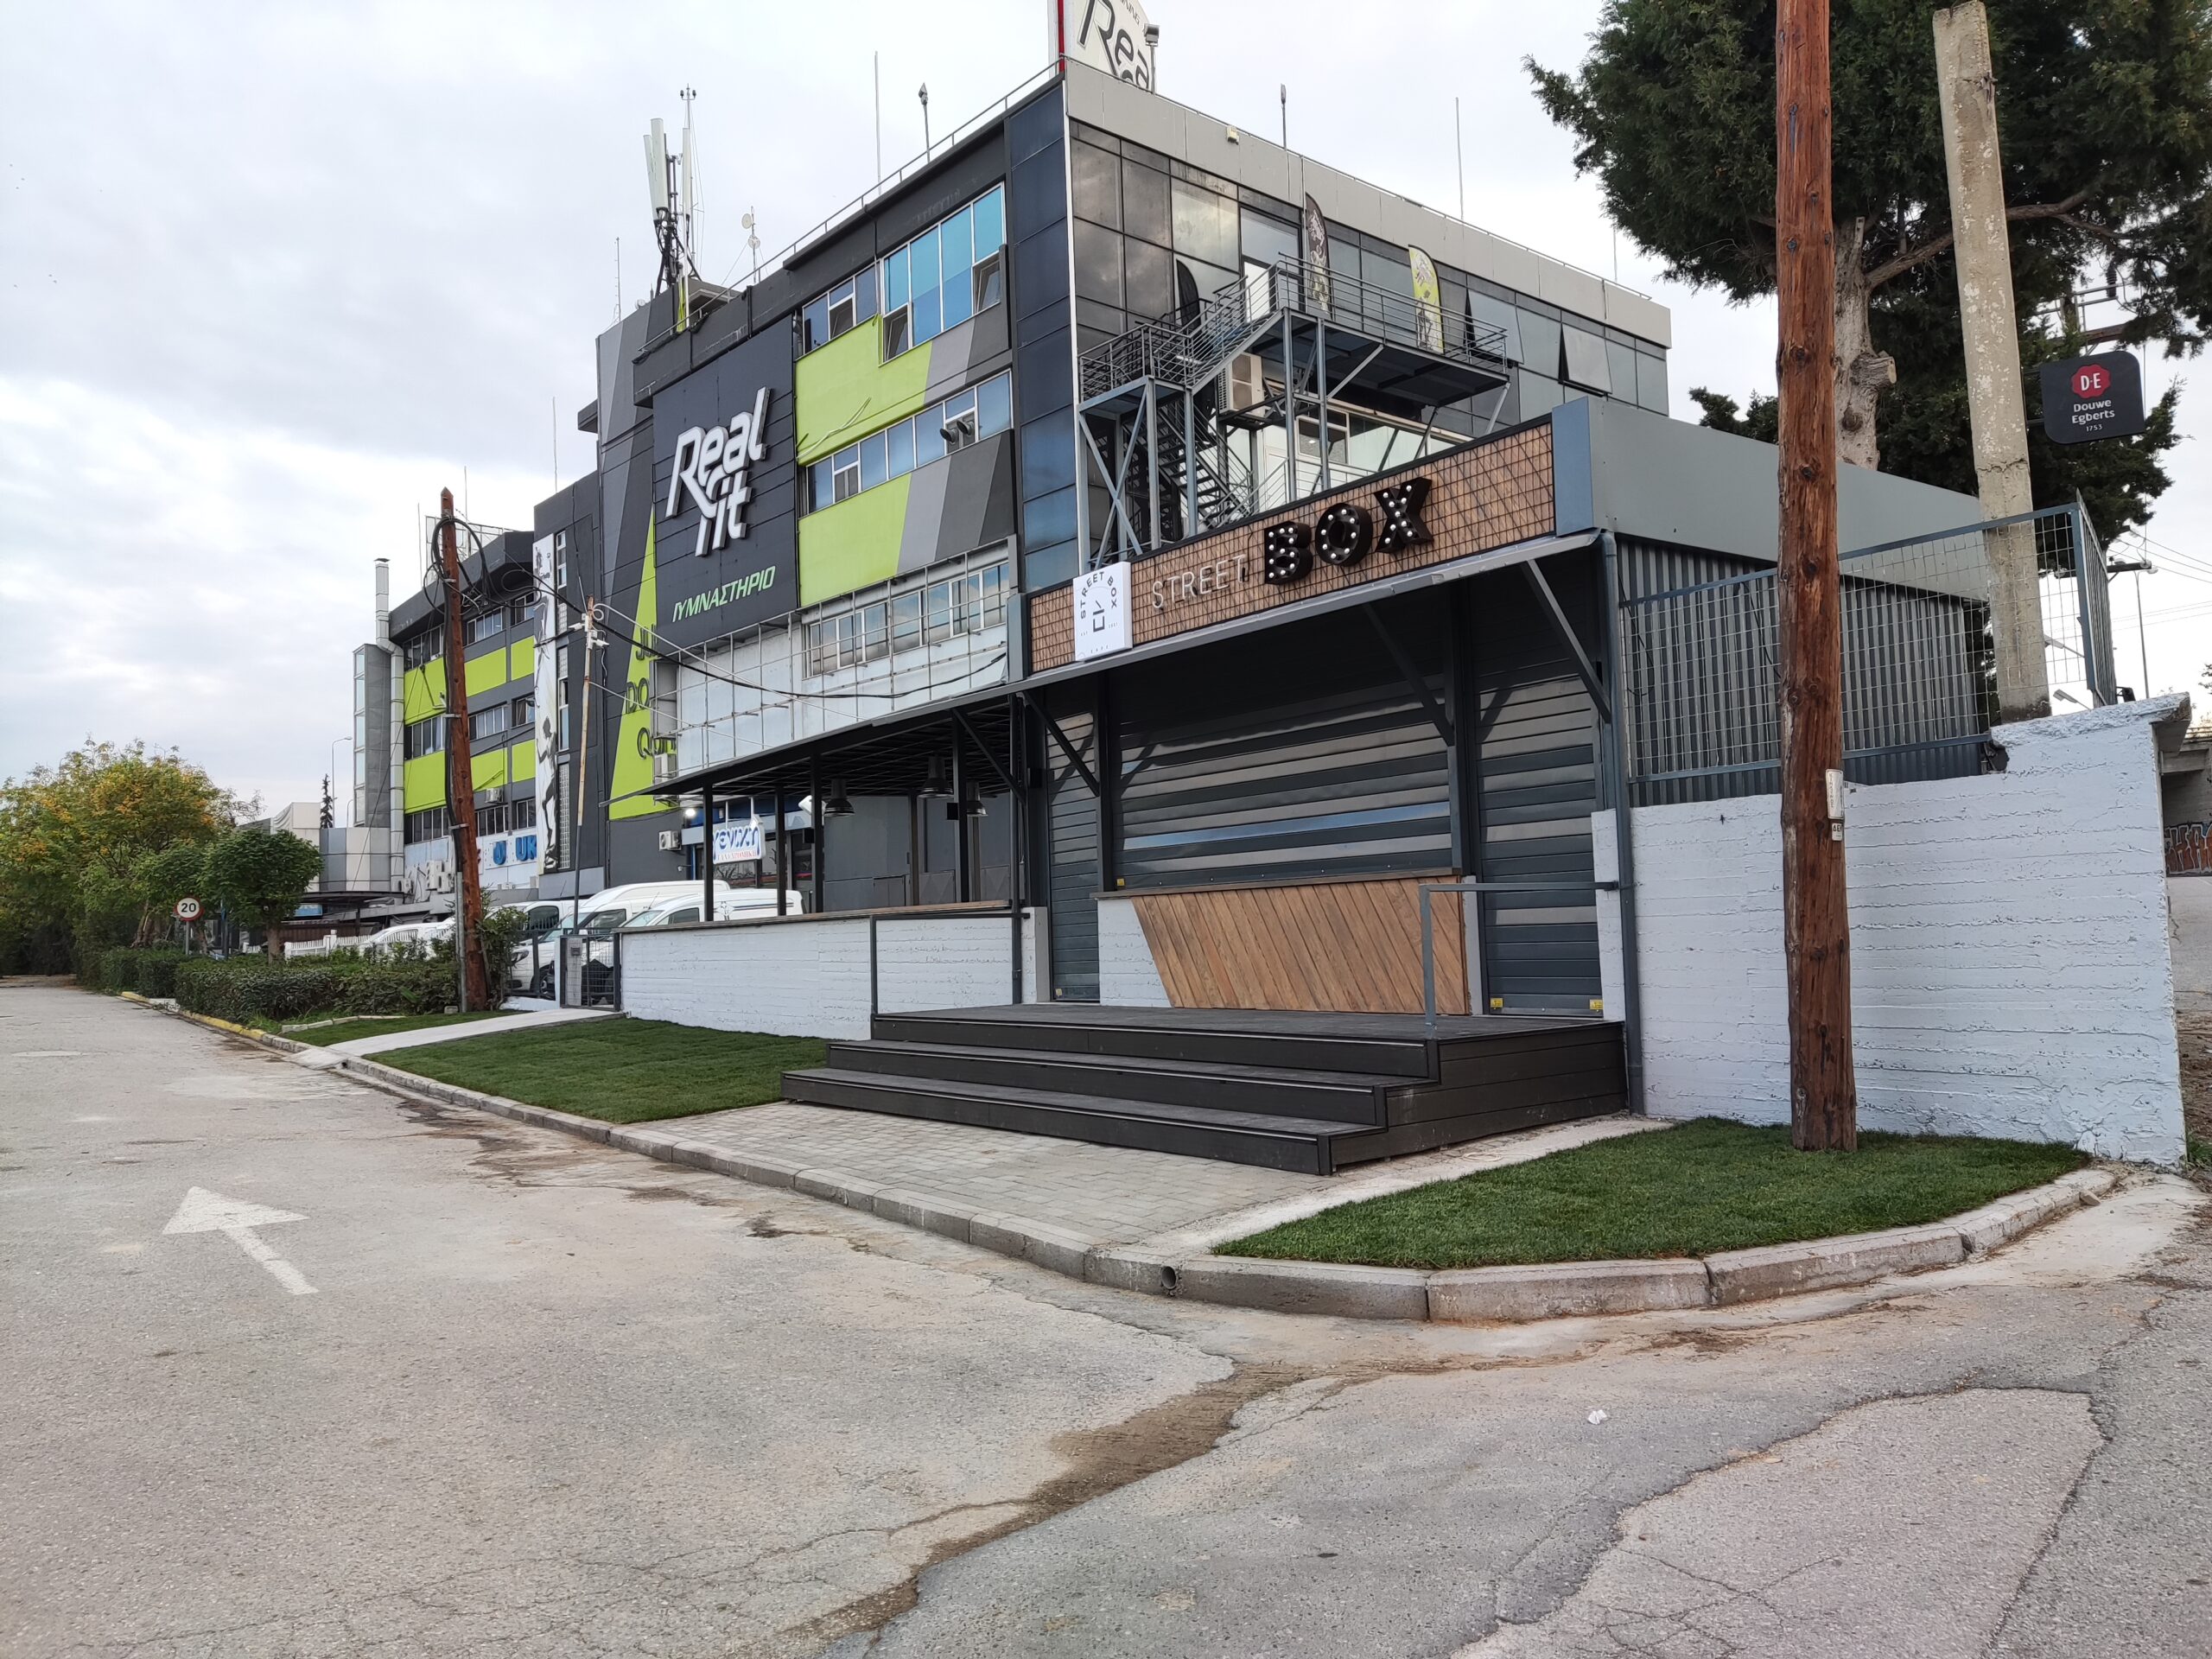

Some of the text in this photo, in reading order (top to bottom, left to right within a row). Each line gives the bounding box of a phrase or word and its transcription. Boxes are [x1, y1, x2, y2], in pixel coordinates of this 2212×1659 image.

[2071, 410, 2115, 425] Egberts
[2074, 399, 2112, 412] Douwe
[2086, 423, 2103, 432] 1753
[664, 386, 772, 519] Real
[1152, 477, 1434, 609] STREET BOX
[672, 565, 776, 623] ΓΥΜΝΑΣΤΗΡΙΟ
[1080, 571, 1117, 620] STREET BOX
[181, 902, 196, 913] 20
